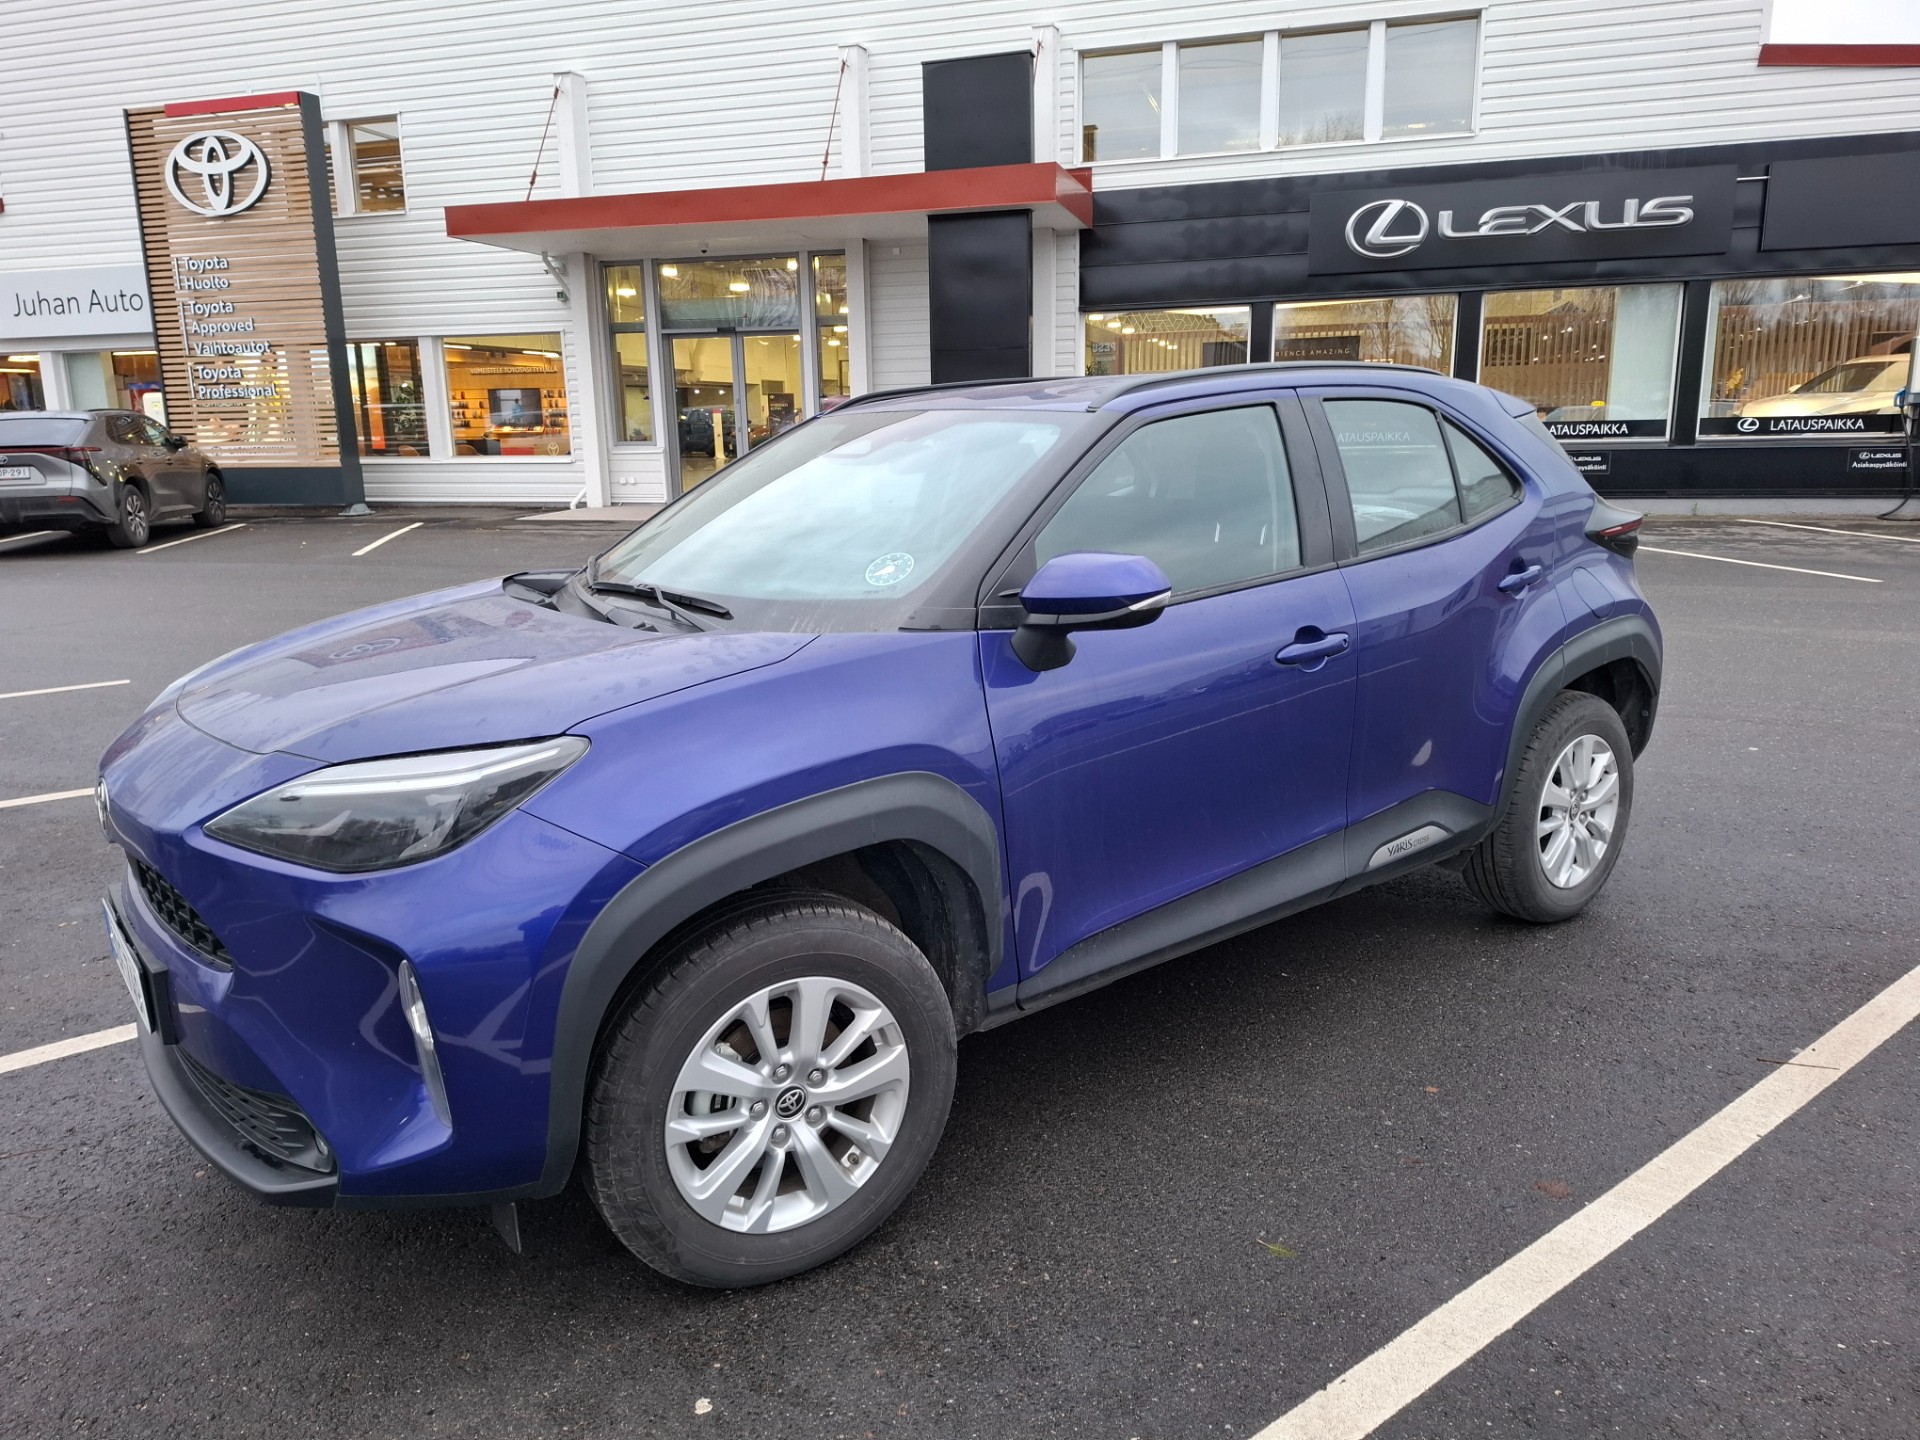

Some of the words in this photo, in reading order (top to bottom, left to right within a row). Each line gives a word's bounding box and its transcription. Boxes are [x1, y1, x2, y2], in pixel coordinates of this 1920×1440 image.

[1437, 195, 1694, 240] LEXUS
[182, 256, 229, 273] Toyota
[184, 275, 230, 291] Huolto
[13, 290, 81, 317] Juhan
[88, 288, 144, 313] Auto
[188, 300, 234, 318] Toyota
[191, 317, 254, 336] Approved
[194, 341, 271, 355] Vaihtoautot
[196, 365, 243, 382] Toyota
[198, 384, 277, 399] Professional
[1549, 423, 1629, 436] ATAUSPAIKKA
[1770, 418, 1865, 431] LATAUSPAIKKA
[1337, 432, 1411, 443] ATAUSPAIKKA
[1387, 838, 1413, 857] YARIS
